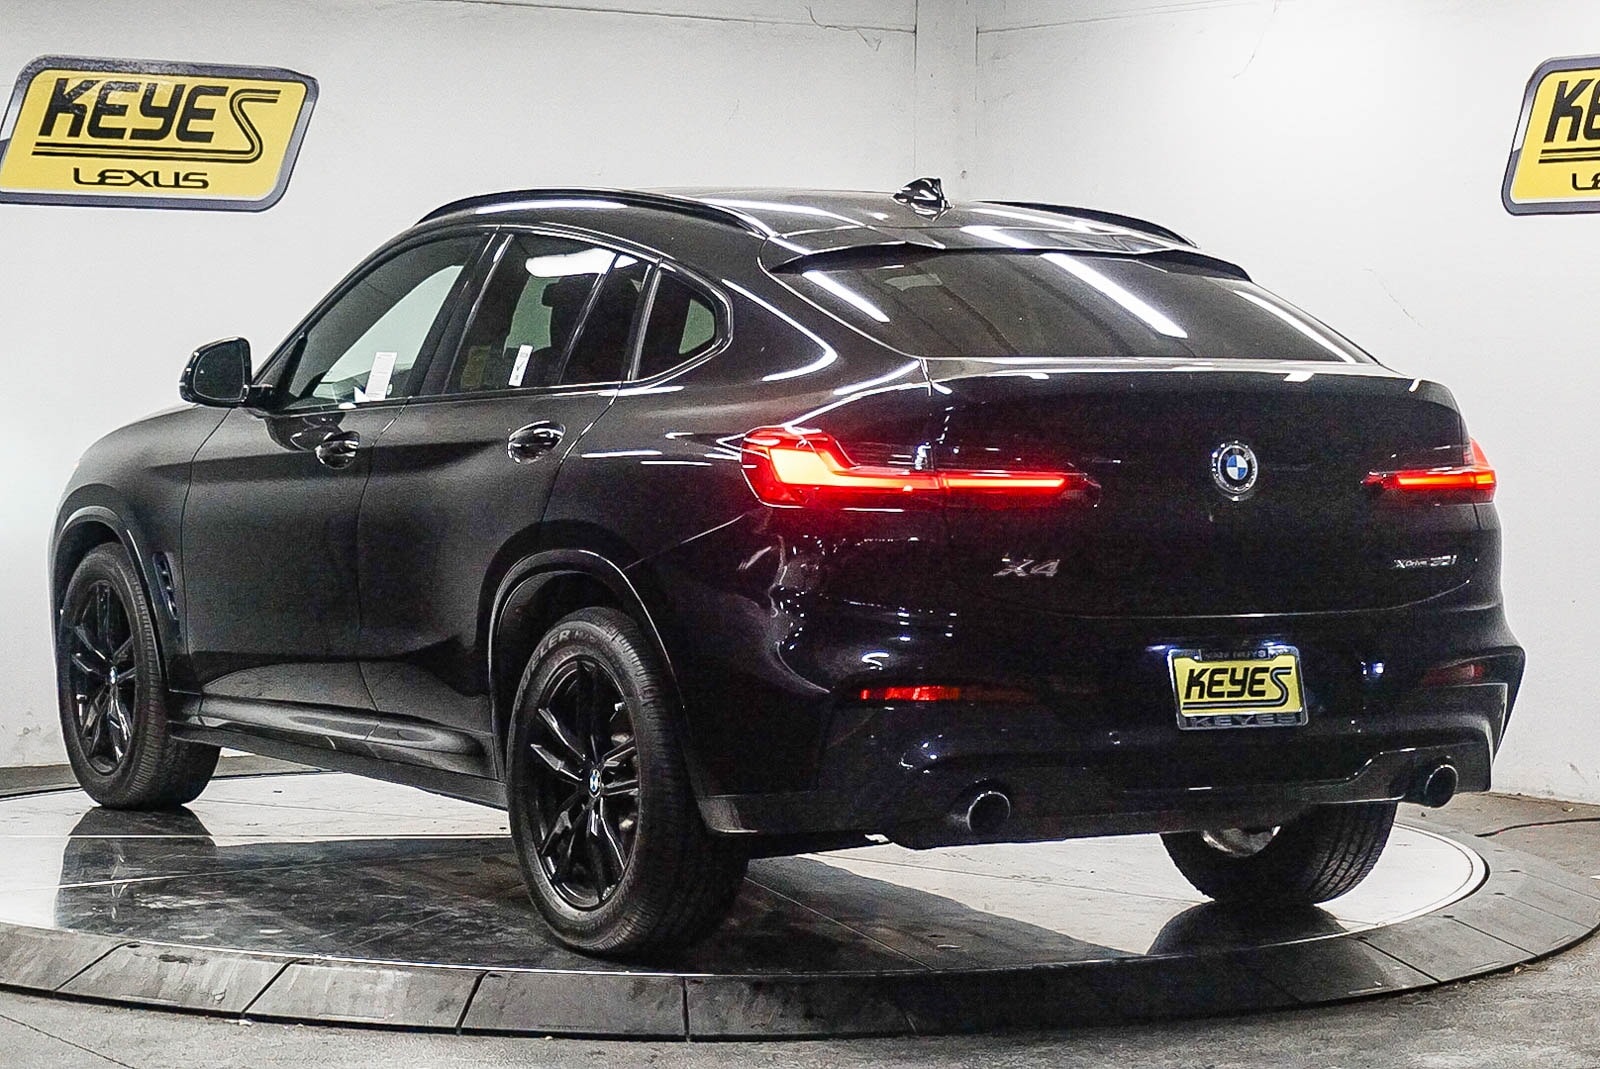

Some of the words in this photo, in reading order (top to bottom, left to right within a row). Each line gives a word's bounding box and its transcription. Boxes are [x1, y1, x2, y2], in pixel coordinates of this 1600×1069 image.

[32, 77, 281, 163] KEYES
[73, 167, 209, 189] LEXUS
[993, 554, 1061, 576] X4
[1182, 666, 1293, 709] KEYES
[1189, 714, 1297, 727] KEYES
